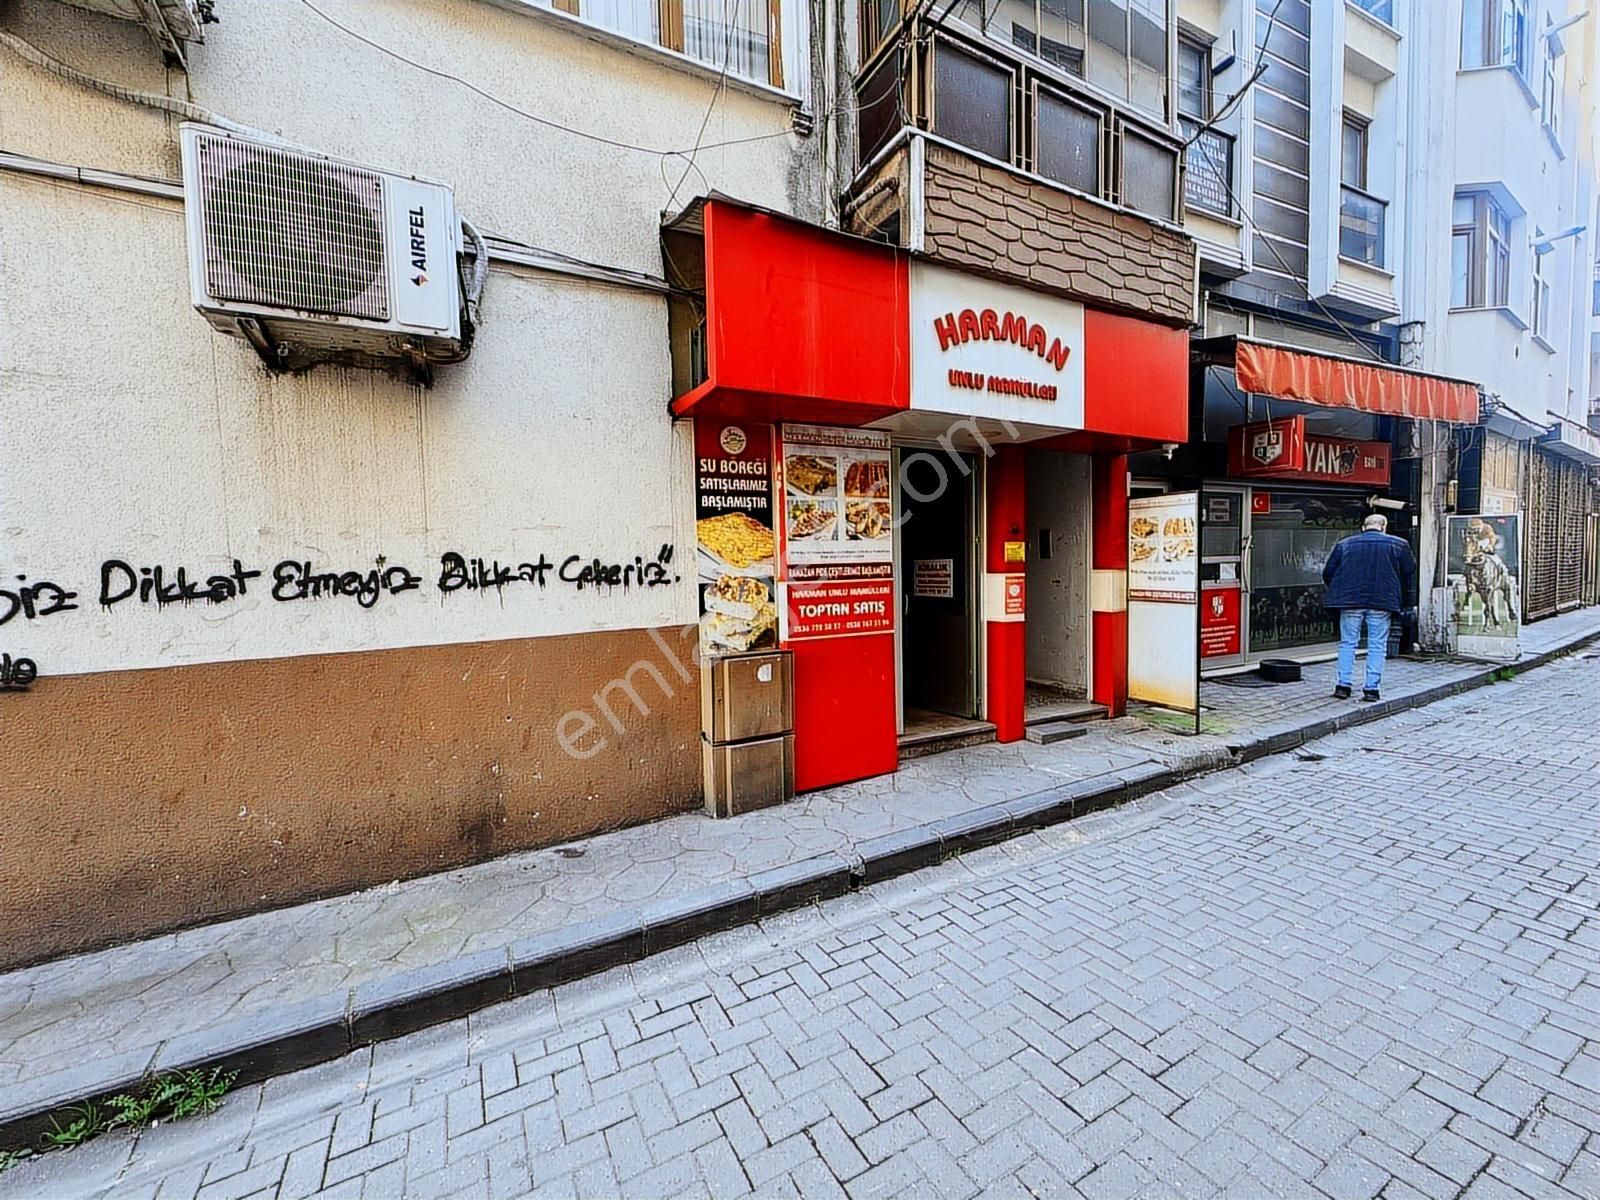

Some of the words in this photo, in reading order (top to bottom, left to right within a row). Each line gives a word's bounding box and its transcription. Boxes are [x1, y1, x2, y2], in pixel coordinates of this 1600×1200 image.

[408, 205, 428, 271] AIRFEL
[933, 308, 1071, 372] HARMAN
[700, 458, 716, 473] SU
[720, 456, 767, 476] BÖREĞİ
[699, 477, 768, 493] SATIŞLARIMIZ
[701, 495, 767, 511] BAŞLAMIŞTIR
[99, 559, 261, 607] Dikkat
[798, 602, 850, 618] TOPTAN
[853, 601, 886, 616] SATIŞ
